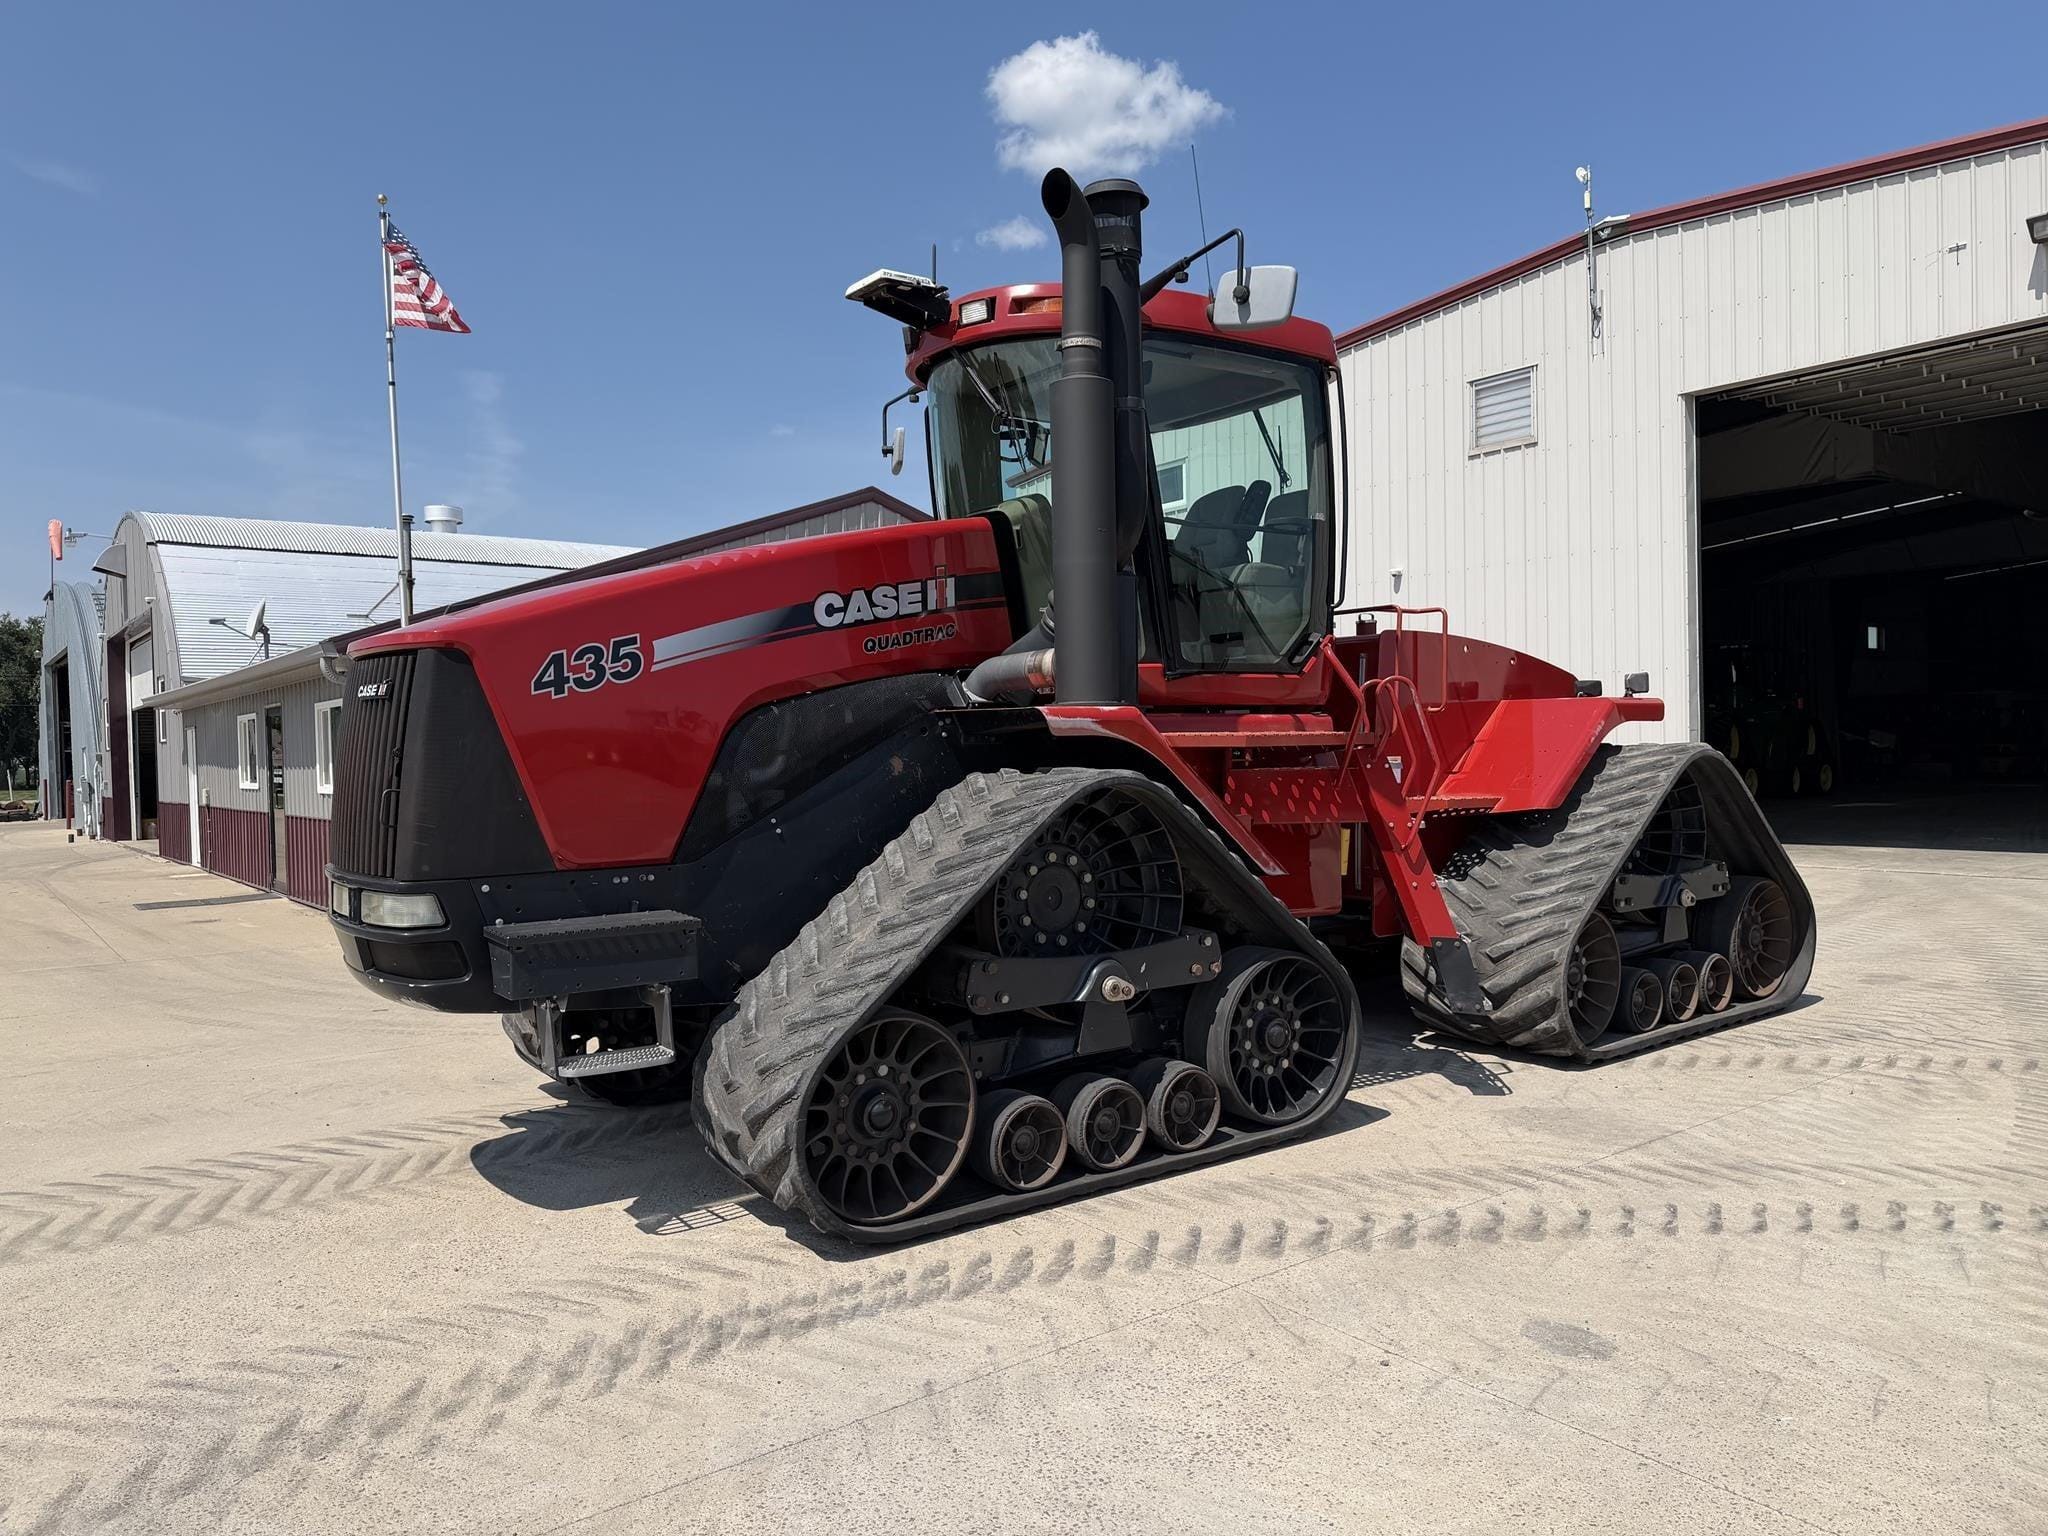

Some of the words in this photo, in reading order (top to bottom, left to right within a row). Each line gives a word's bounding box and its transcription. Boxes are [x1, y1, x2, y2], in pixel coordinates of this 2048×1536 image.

[813, 582, 922, 628] CASE
[863, 623, 957, 655] QUADTRAC
[531, 633, 644, 699] 435
[357, 684, 378, 698] CASE
